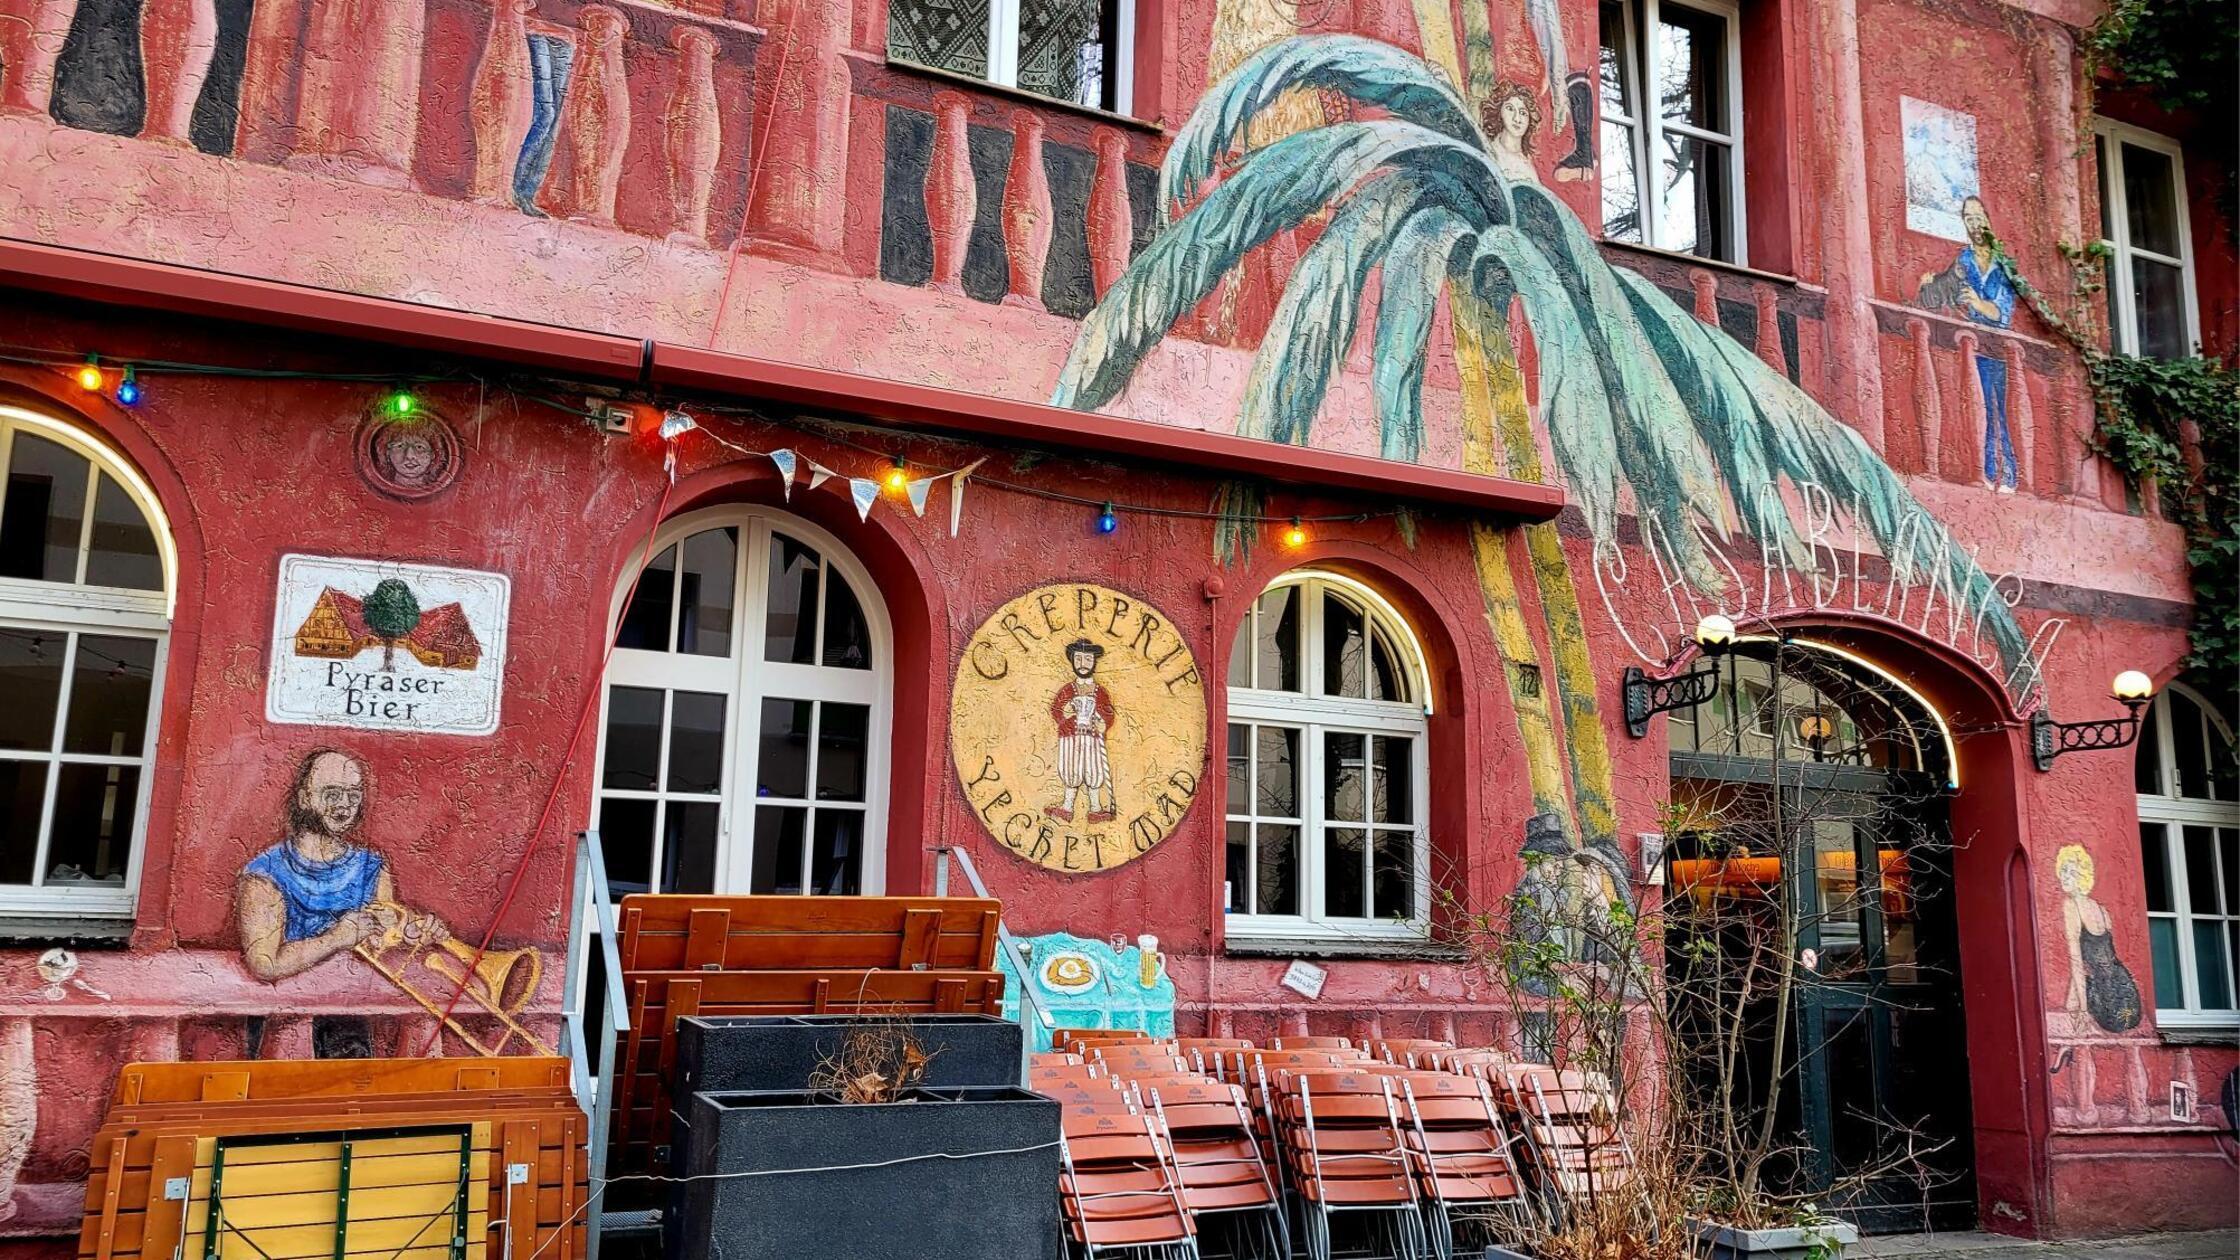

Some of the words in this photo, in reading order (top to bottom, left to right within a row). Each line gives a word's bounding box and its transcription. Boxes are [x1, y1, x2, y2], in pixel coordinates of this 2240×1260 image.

[1592, 480, 2071, 705] CASABLANCA
[971, 588, 1199, 696] CREPERIE
[326, 661, 446, 694] Pyraser
[1518, 671, 1535, 694] 12
[345, 688, 420, 720] Bier
